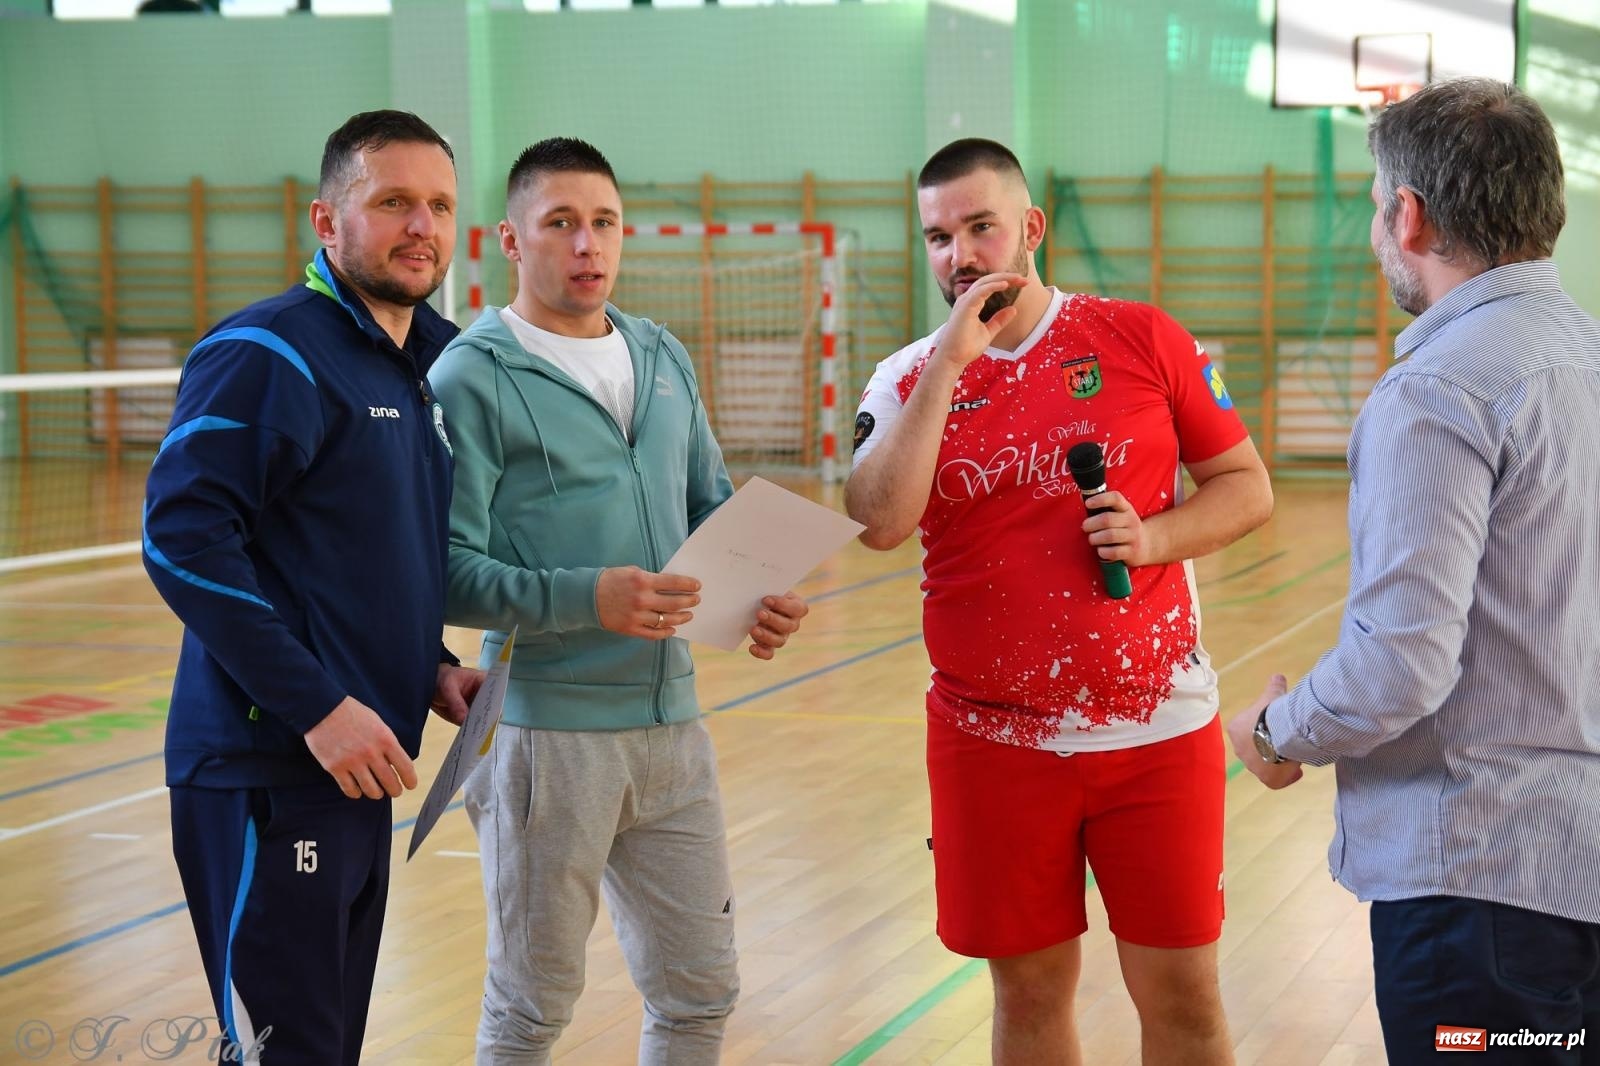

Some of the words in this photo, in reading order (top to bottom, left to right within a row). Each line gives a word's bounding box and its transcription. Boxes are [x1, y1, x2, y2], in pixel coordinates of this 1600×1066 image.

[948, 398, 987, 412] ina
[1047, 419, 1096, 442] Willa
[937, 432, 1134, 501] Wiktia
[293, 840, 318, 873] 15
